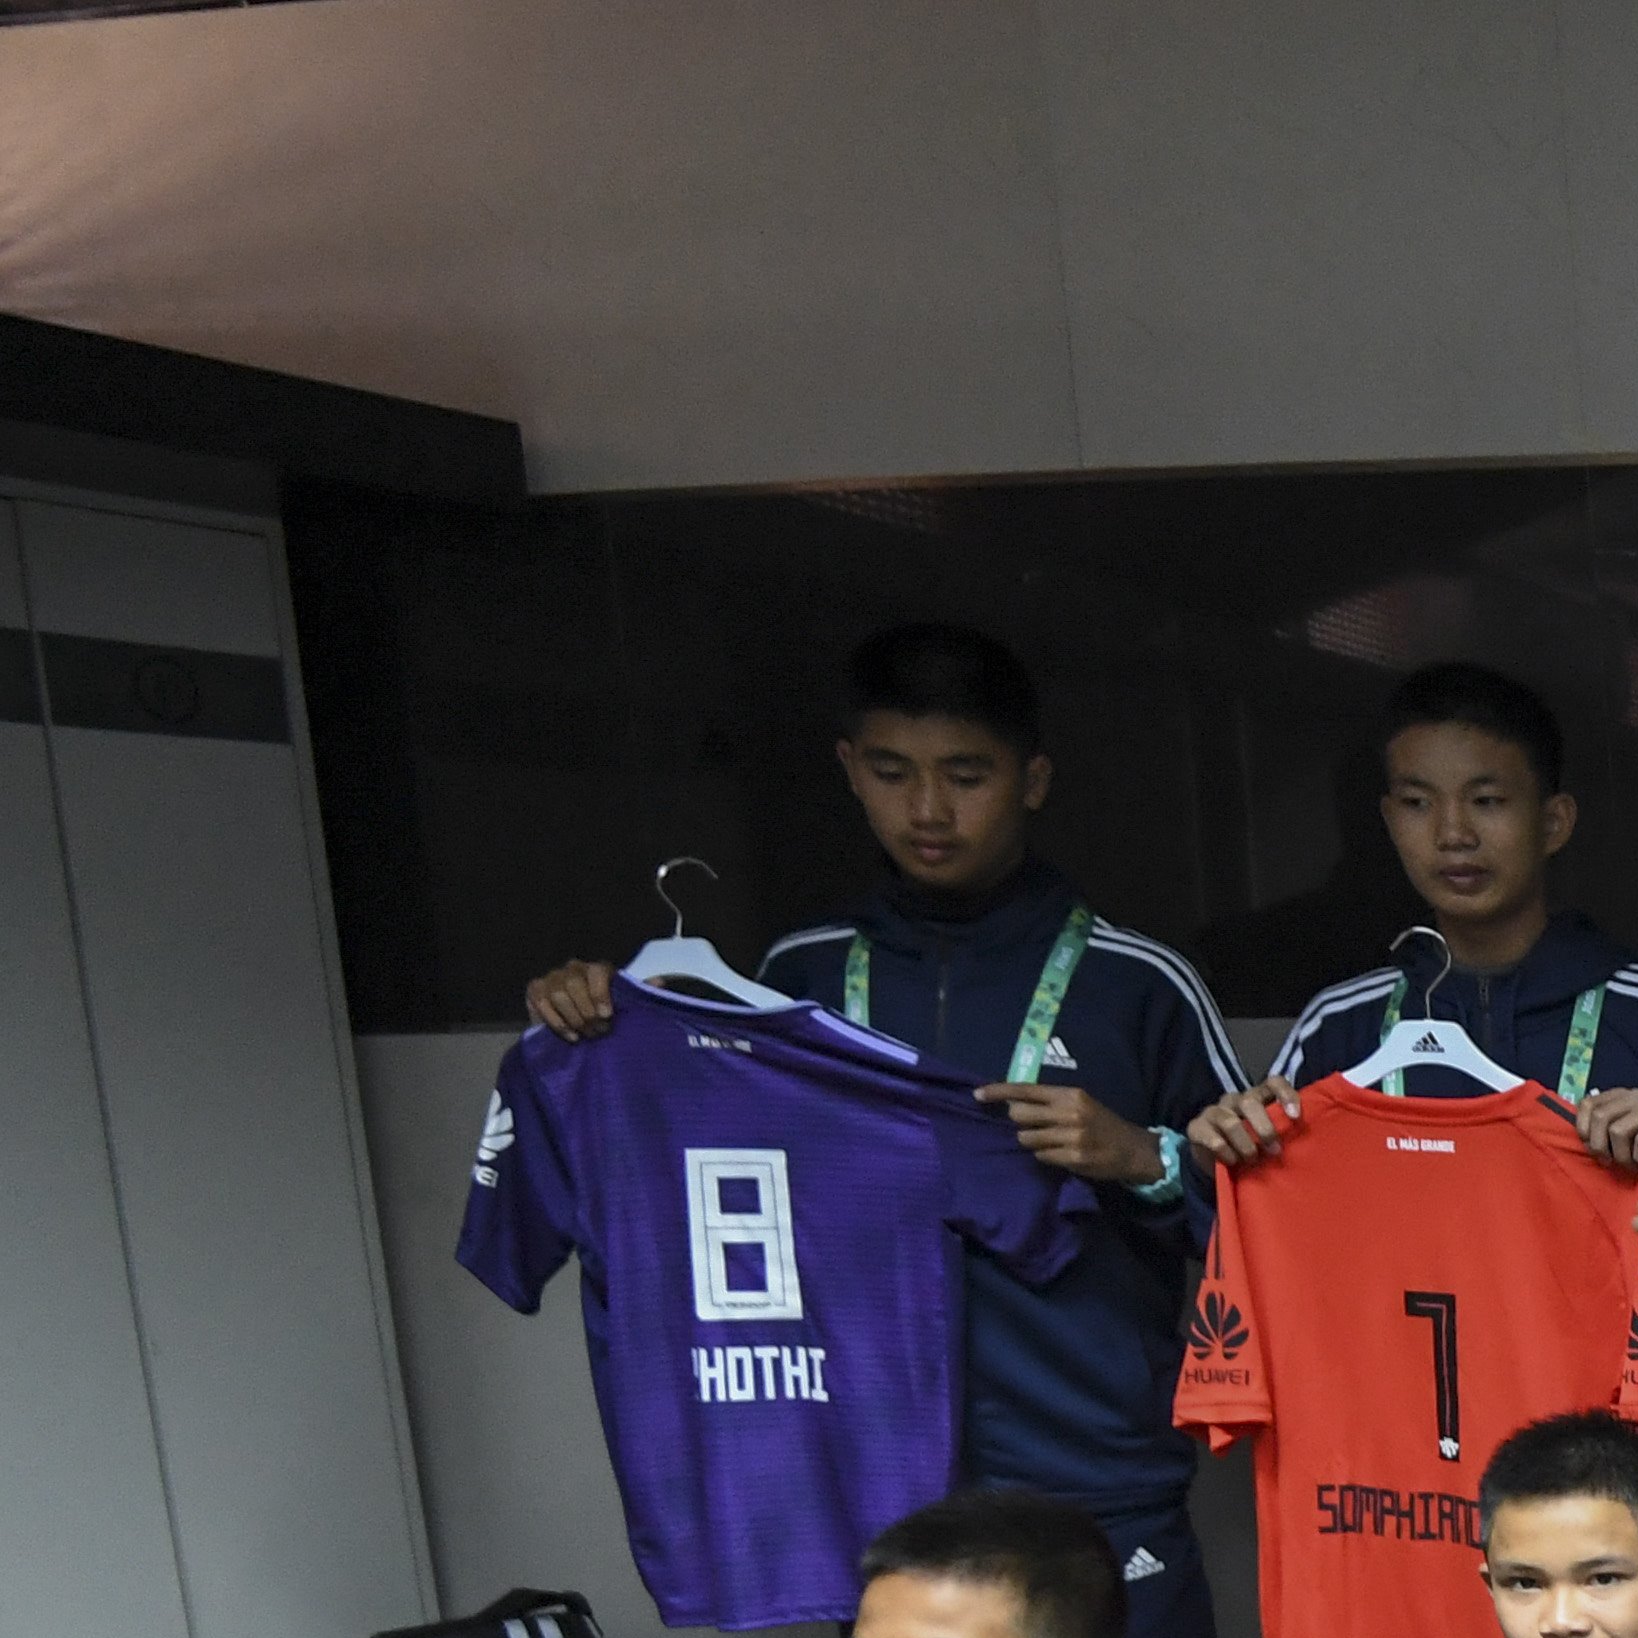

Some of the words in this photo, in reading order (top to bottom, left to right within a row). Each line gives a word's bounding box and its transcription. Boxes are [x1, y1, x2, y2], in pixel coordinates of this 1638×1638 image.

[685, 1147, 805, 1321] 8
[691, 1345, 831, 1404] HOTHI
[1403, 1290, 1462, 1464] 1
